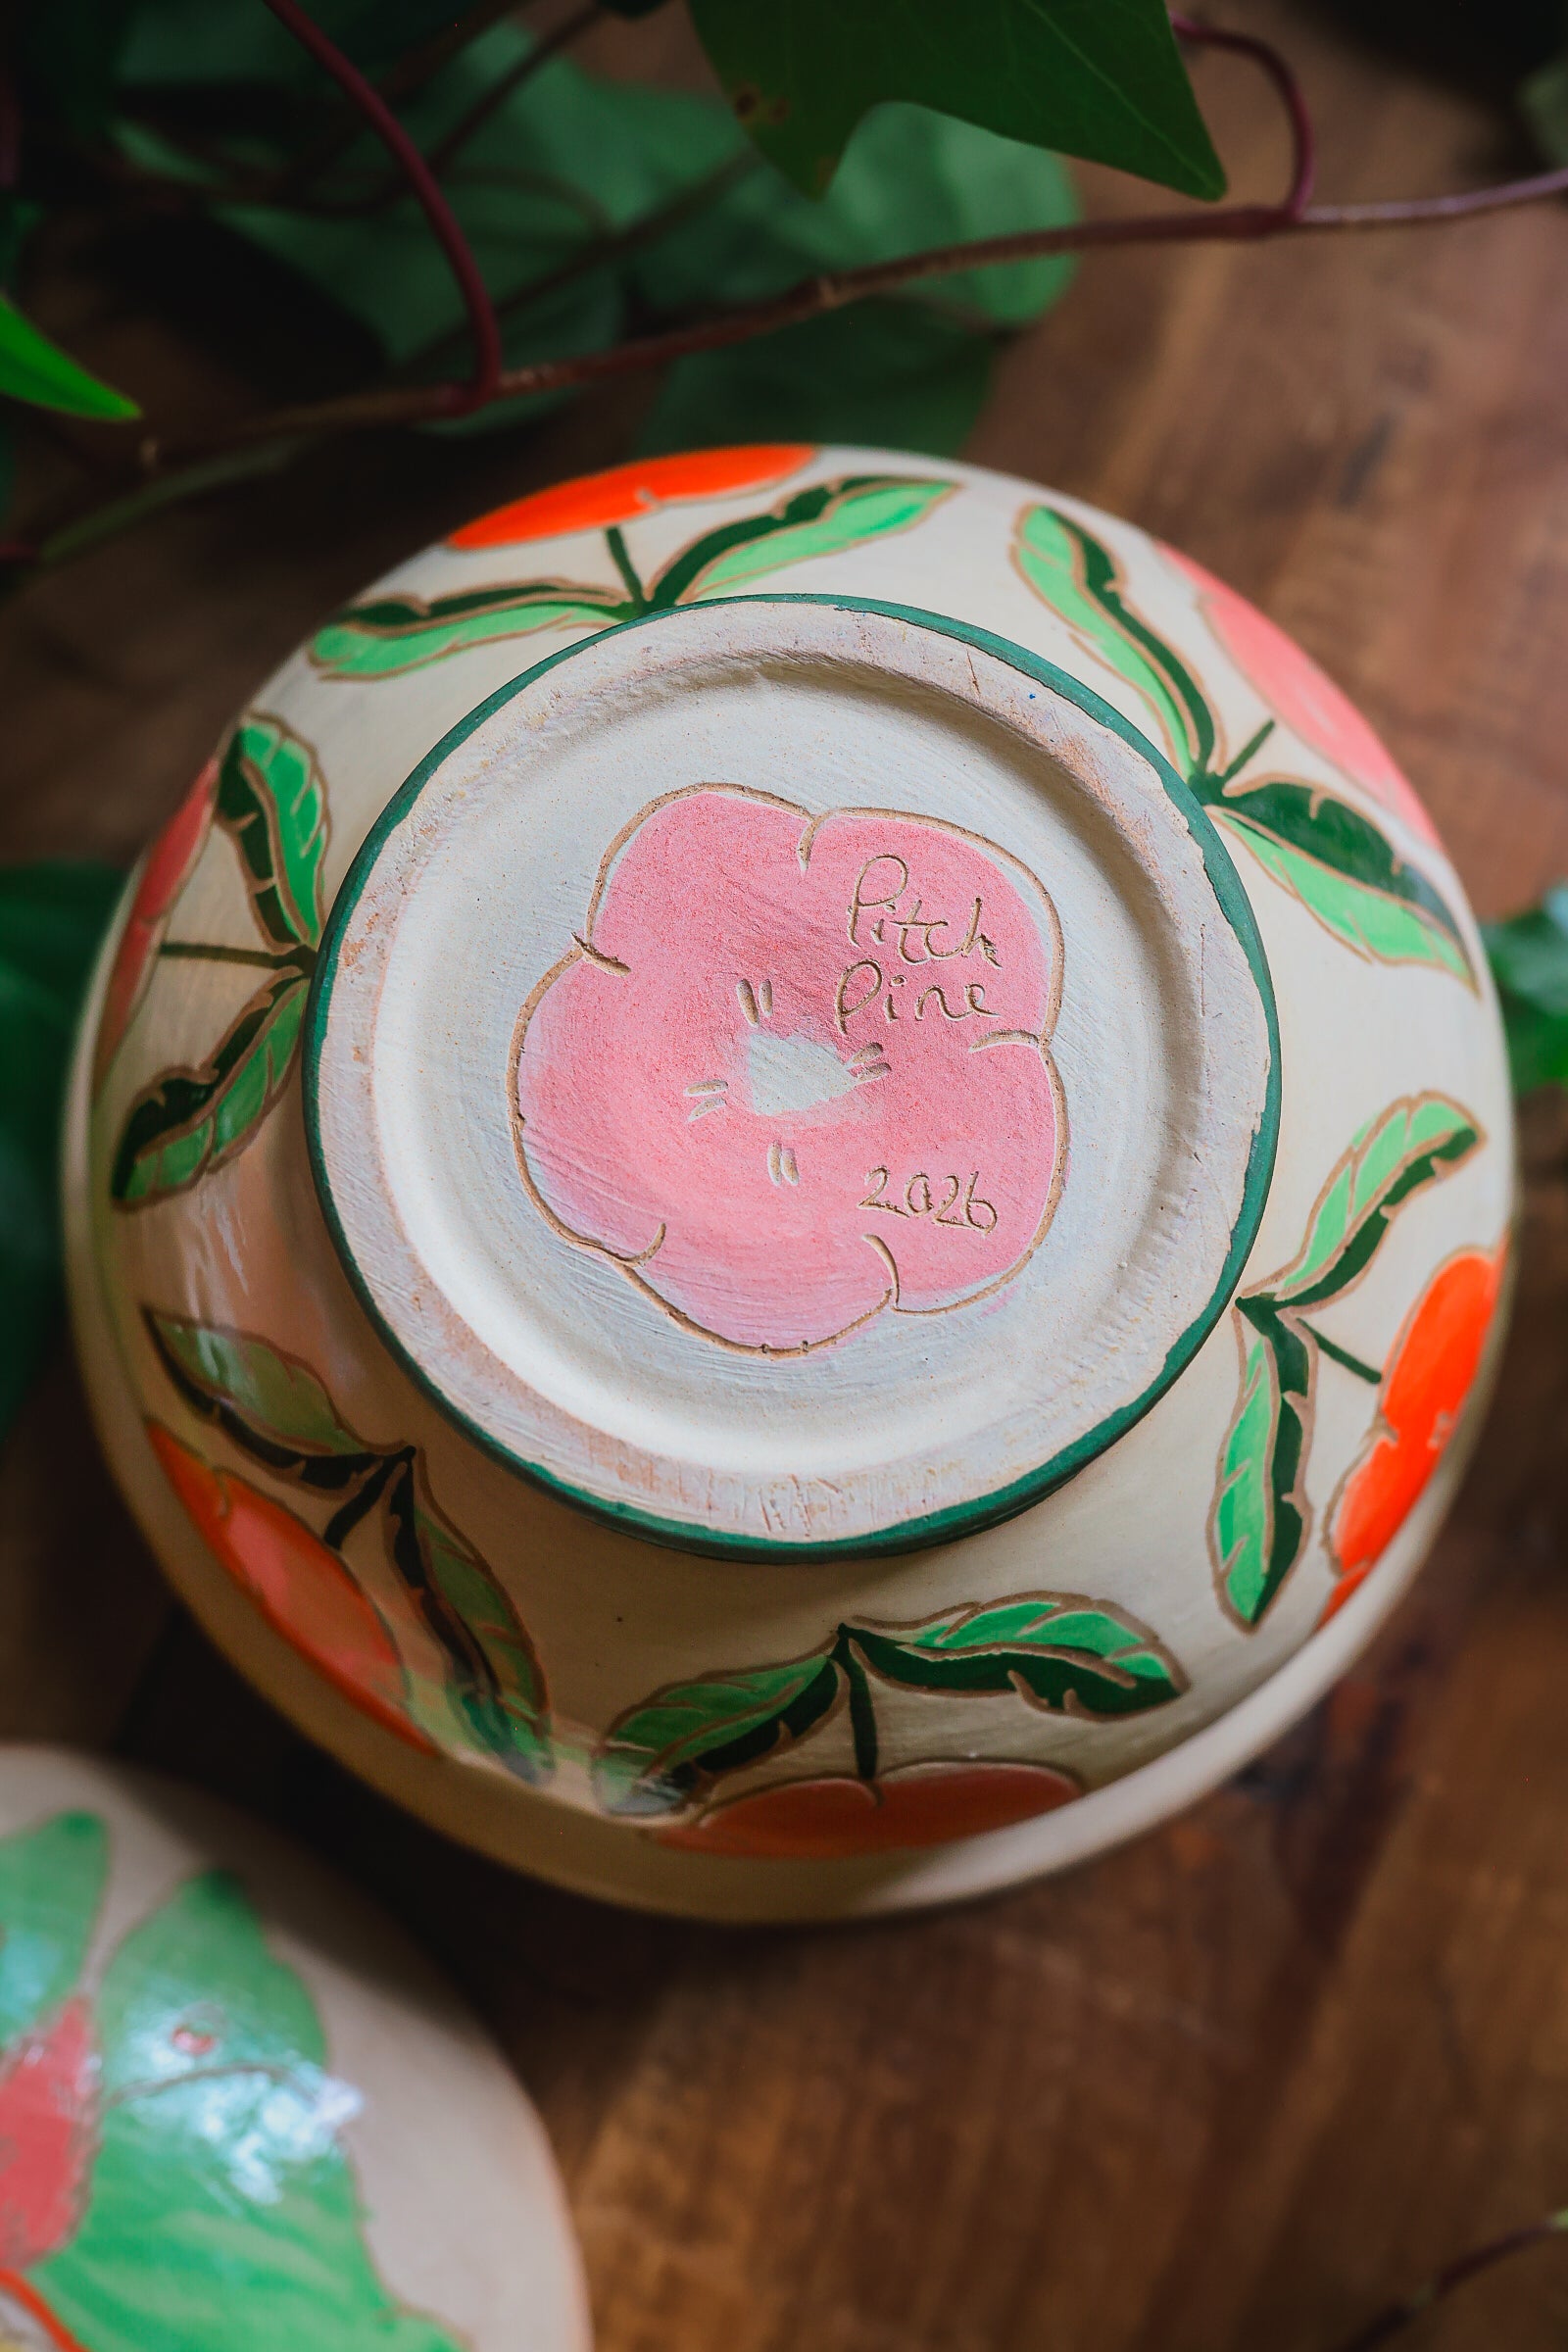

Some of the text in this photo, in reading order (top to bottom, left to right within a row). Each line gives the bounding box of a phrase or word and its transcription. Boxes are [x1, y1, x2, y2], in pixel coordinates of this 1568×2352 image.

[849, 855, 1002, 967] Pitch
[836, 959, 1000, 1035] Pine
[858, 1166, 998, 1235] 2026
